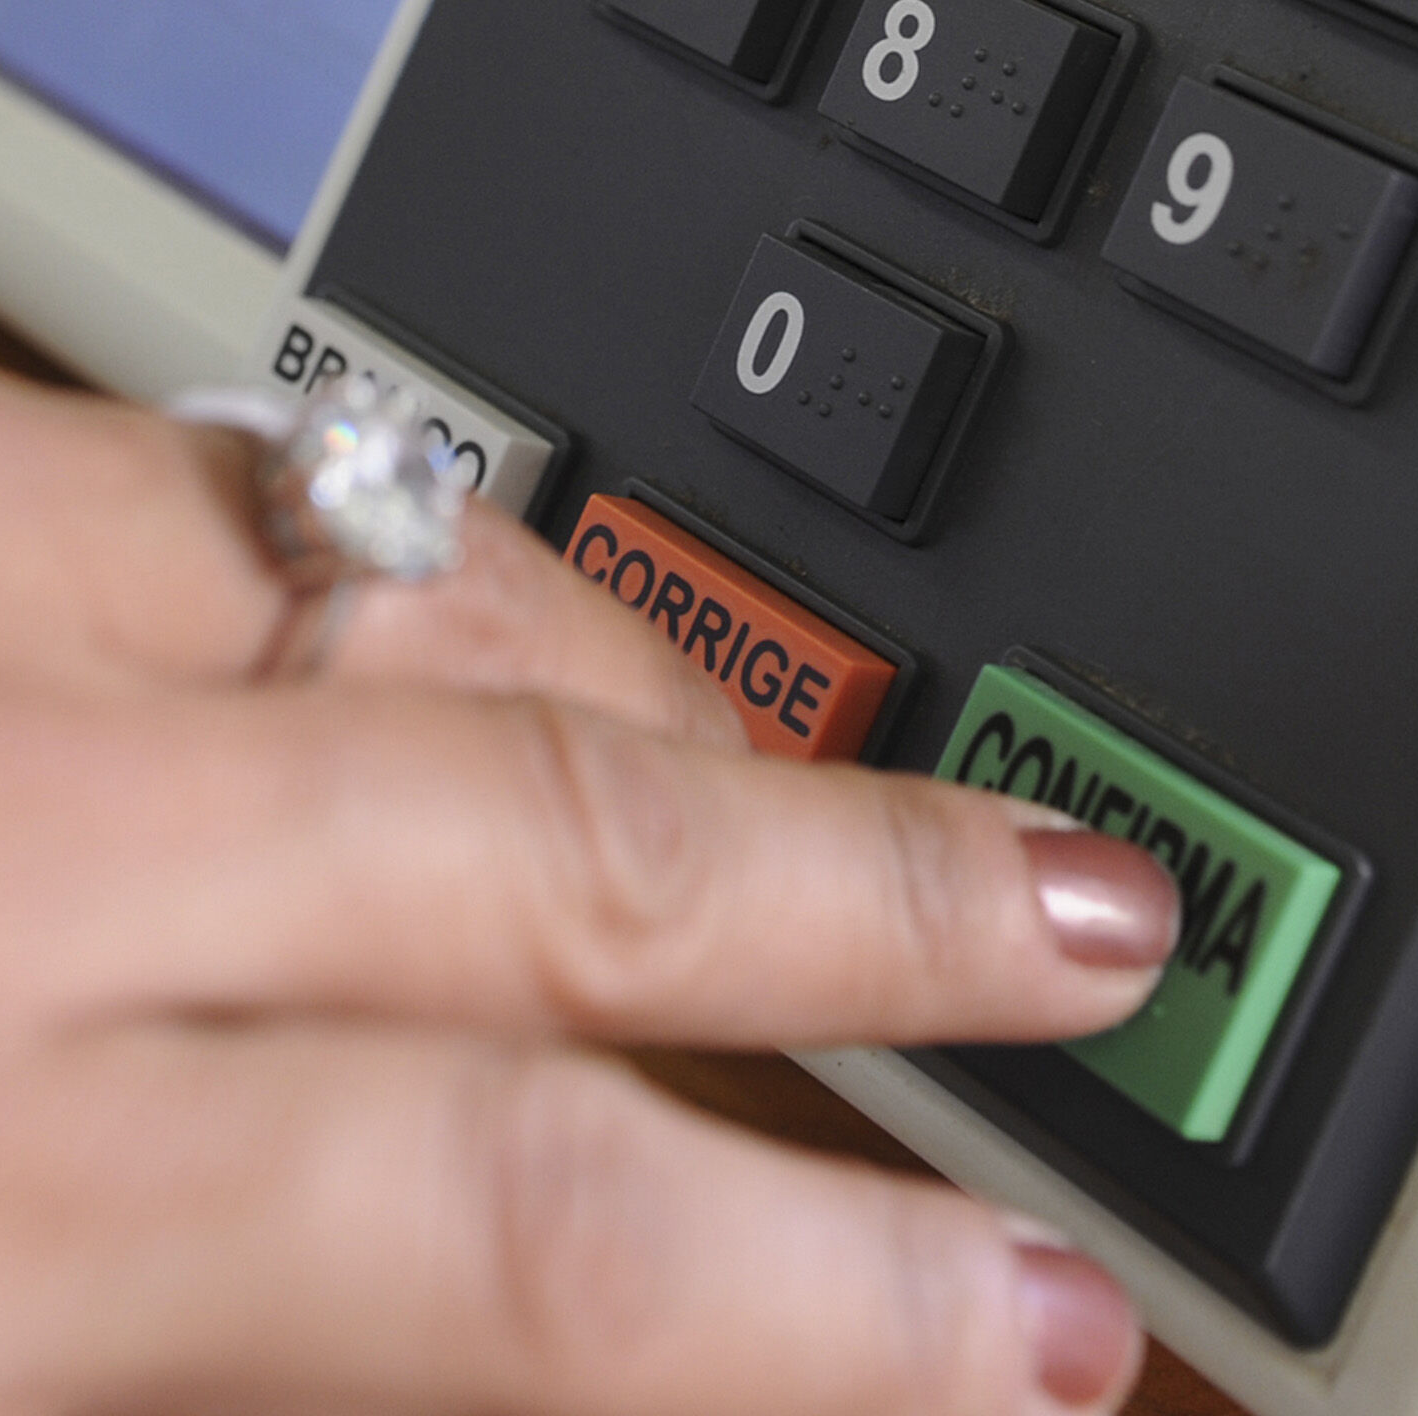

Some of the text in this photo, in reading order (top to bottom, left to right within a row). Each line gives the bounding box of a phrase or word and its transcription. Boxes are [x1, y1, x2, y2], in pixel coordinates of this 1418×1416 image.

[1150, 132, 1234, 245] 9
[273, 323, 488, 495] BRO
[735, 290, 805, 395] 0
[572, 523, 831, 739] CORRIGE
